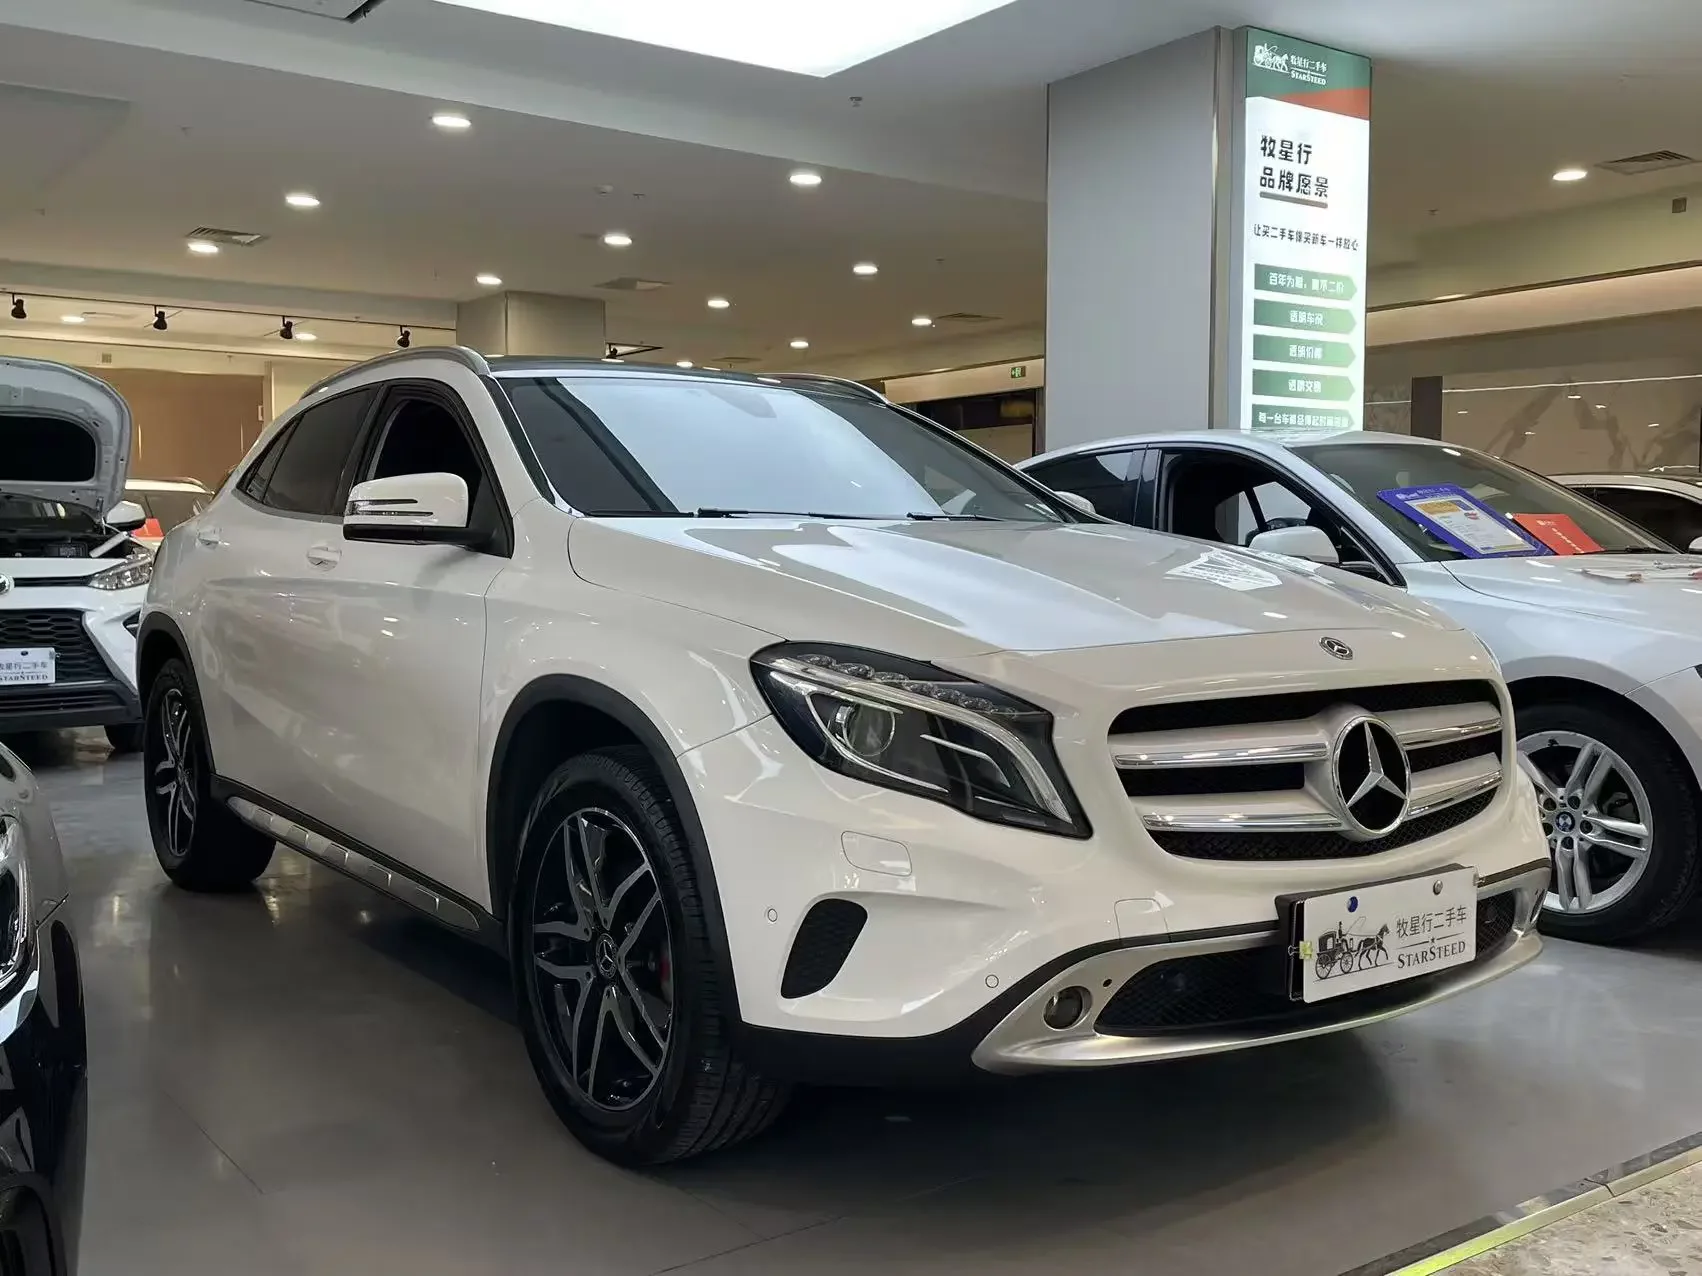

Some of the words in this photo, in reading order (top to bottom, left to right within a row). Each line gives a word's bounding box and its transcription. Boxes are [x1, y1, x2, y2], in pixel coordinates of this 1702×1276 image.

[1260, 134, 1312, 165] 牧星行
[1259, 166, 1329, 198] 品牌愿景
[1396, 905, 1467, 938] 牧星行二手车
[1397, 941, 1466, 968] STARSTEED
